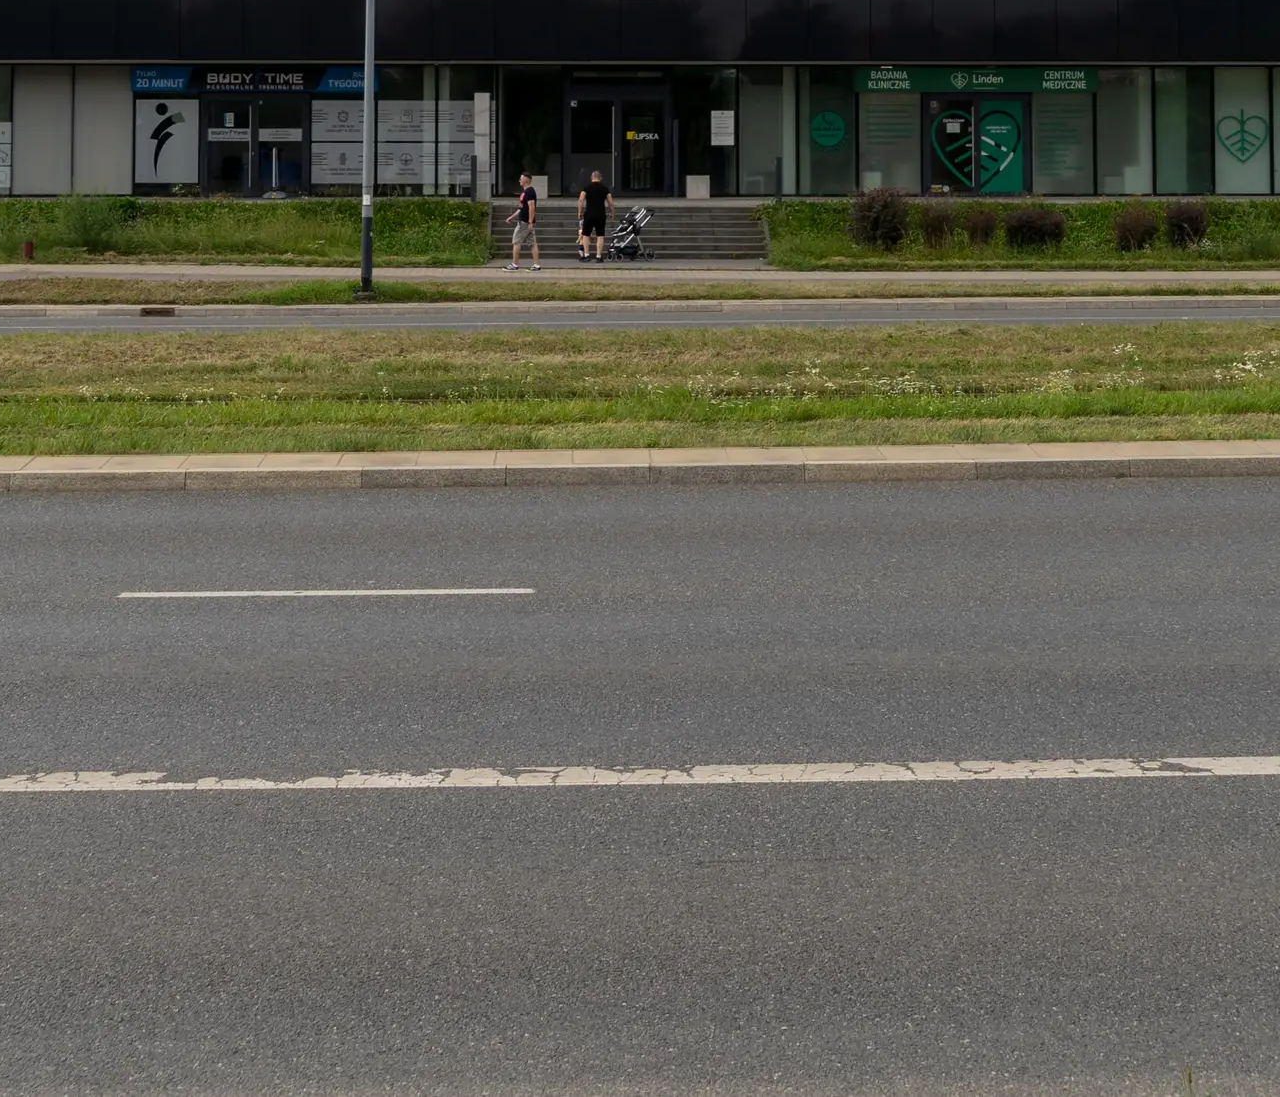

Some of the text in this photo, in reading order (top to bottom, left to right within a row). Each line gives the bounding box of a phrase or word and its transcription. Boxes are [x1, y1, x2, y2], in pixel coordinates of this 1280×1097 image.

[206, 72, 304, 84] BODY TIME
[870, 70, 908, 80] BADANIA
[972, 73, 1004, 85] Linden
[1043, 70, 1085, 79] CENTRUM
[135, 78, 184, 88] 20 MINUT
[867, 80, 911, 90] KLINICZNE
[1042, 80, 1087, 90] MEDYCZNE
